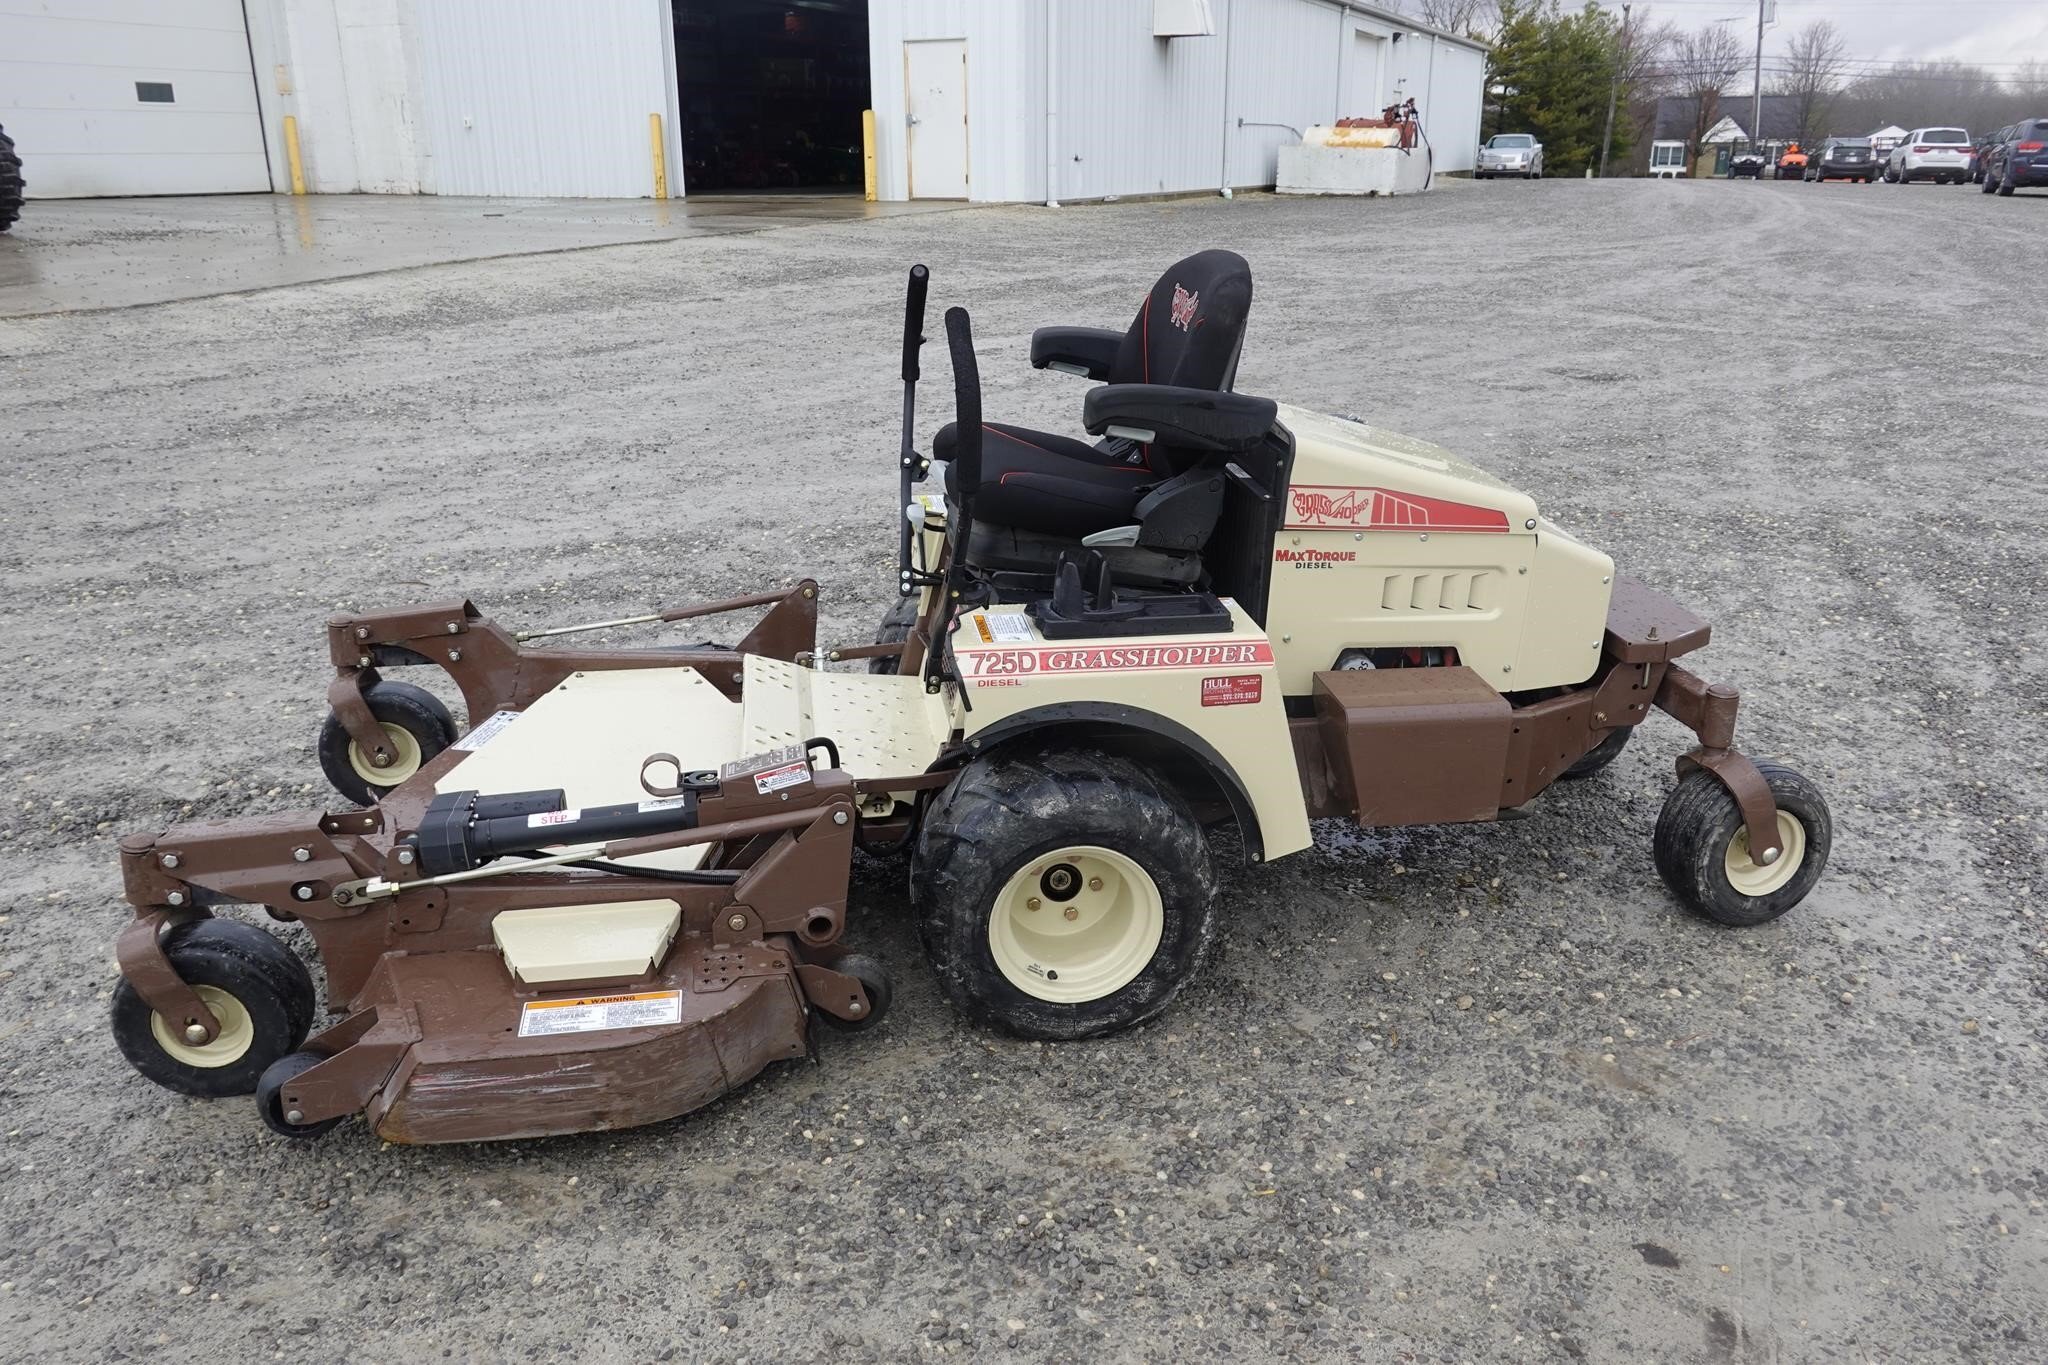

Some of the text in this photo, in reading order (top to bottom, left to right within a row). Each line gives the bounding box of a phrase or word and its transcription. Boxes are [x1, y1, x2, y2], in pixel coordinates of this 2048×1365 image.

[970, 645, 1256, 674] 725D GRASSHOPPER
[977, 679, 1022, 688] DIESEL
[1203, 678, 1231, 688] HULL
[540, 814, 568, 825] STEP
[591, 995, 636, 1004] WARNING
